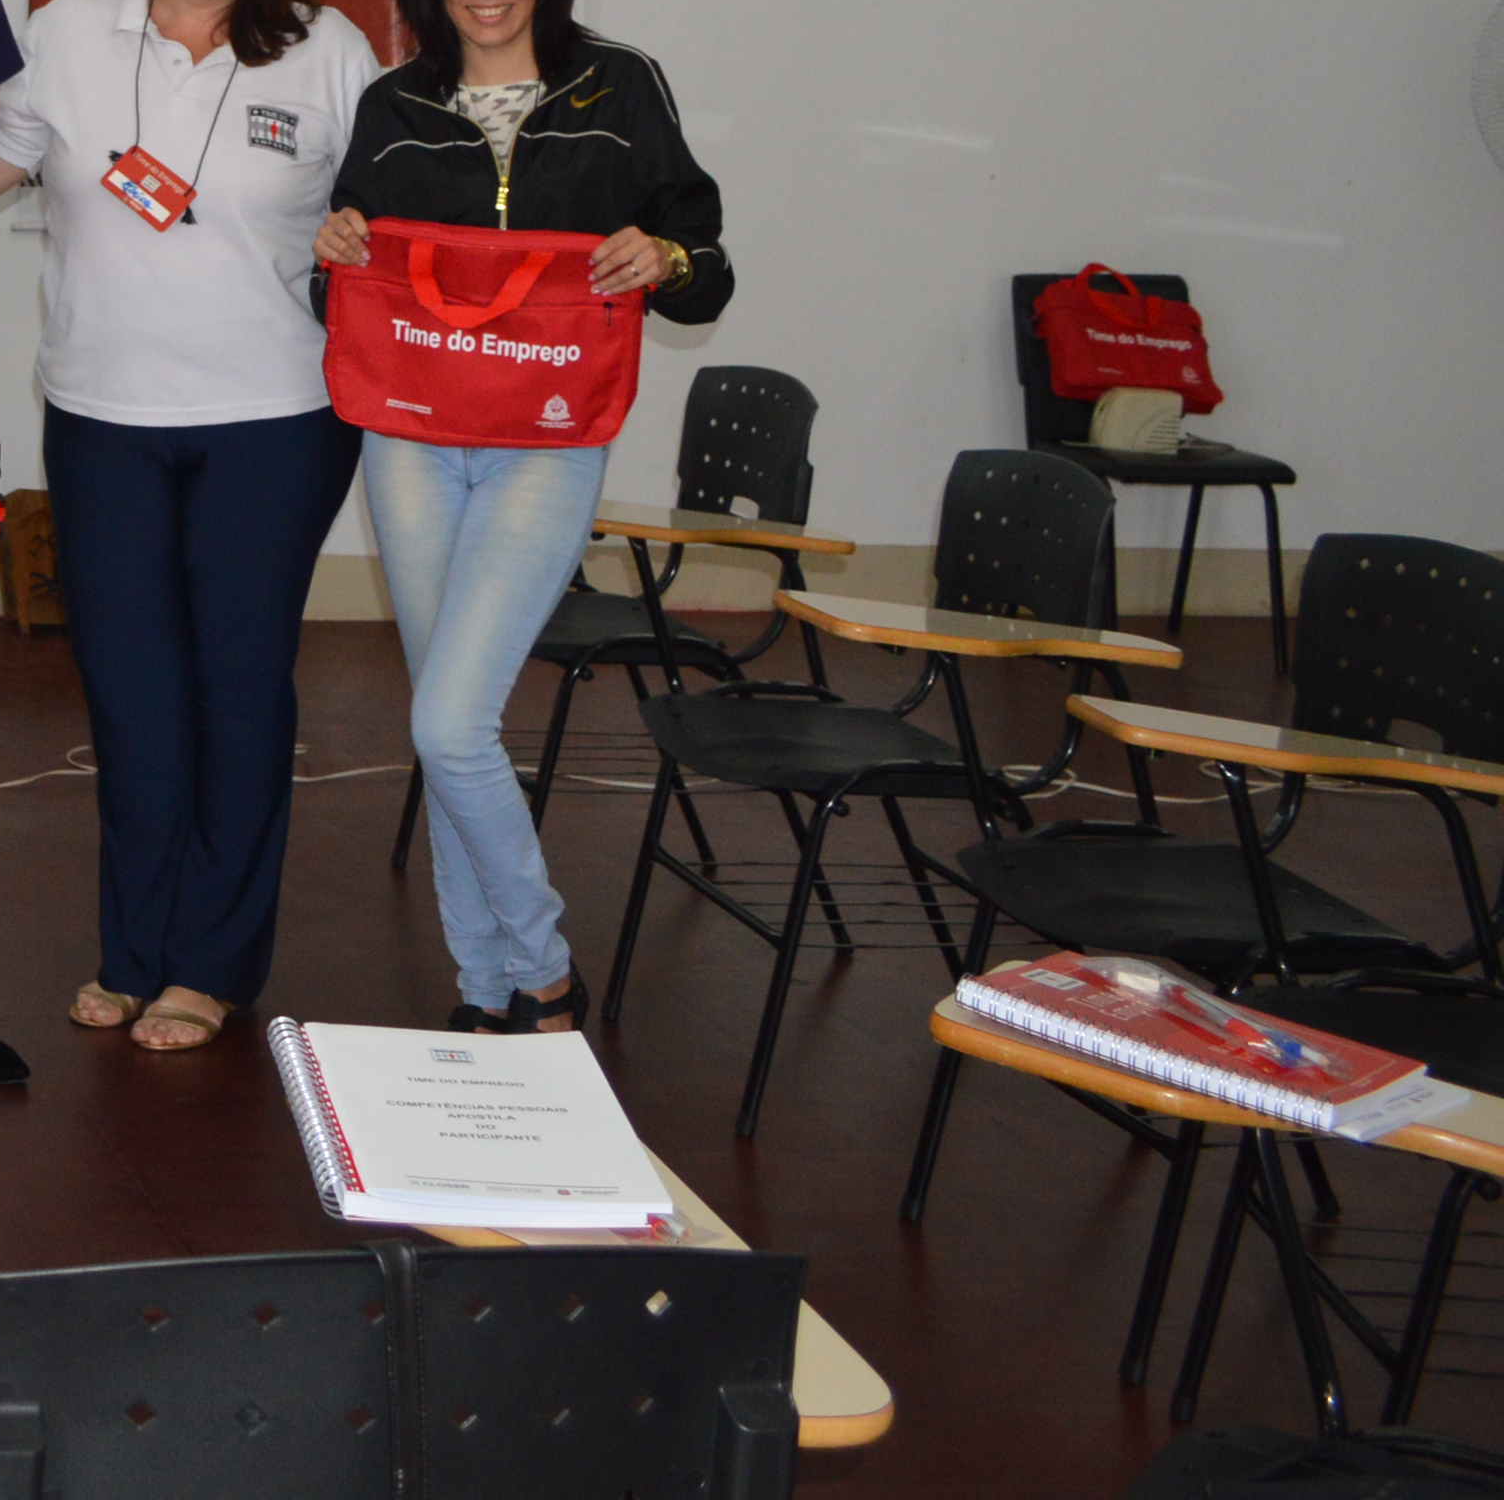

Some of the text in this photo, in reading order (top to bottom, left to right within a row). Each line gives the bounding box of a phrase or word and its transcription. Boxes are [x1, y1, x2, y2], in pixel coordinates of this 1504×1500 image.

[391, 318, 581, 367] Time do Emprego
[1086, 327, 1193, 352] Time do Emprego
[406, 1075, 436, 1084] TIME
